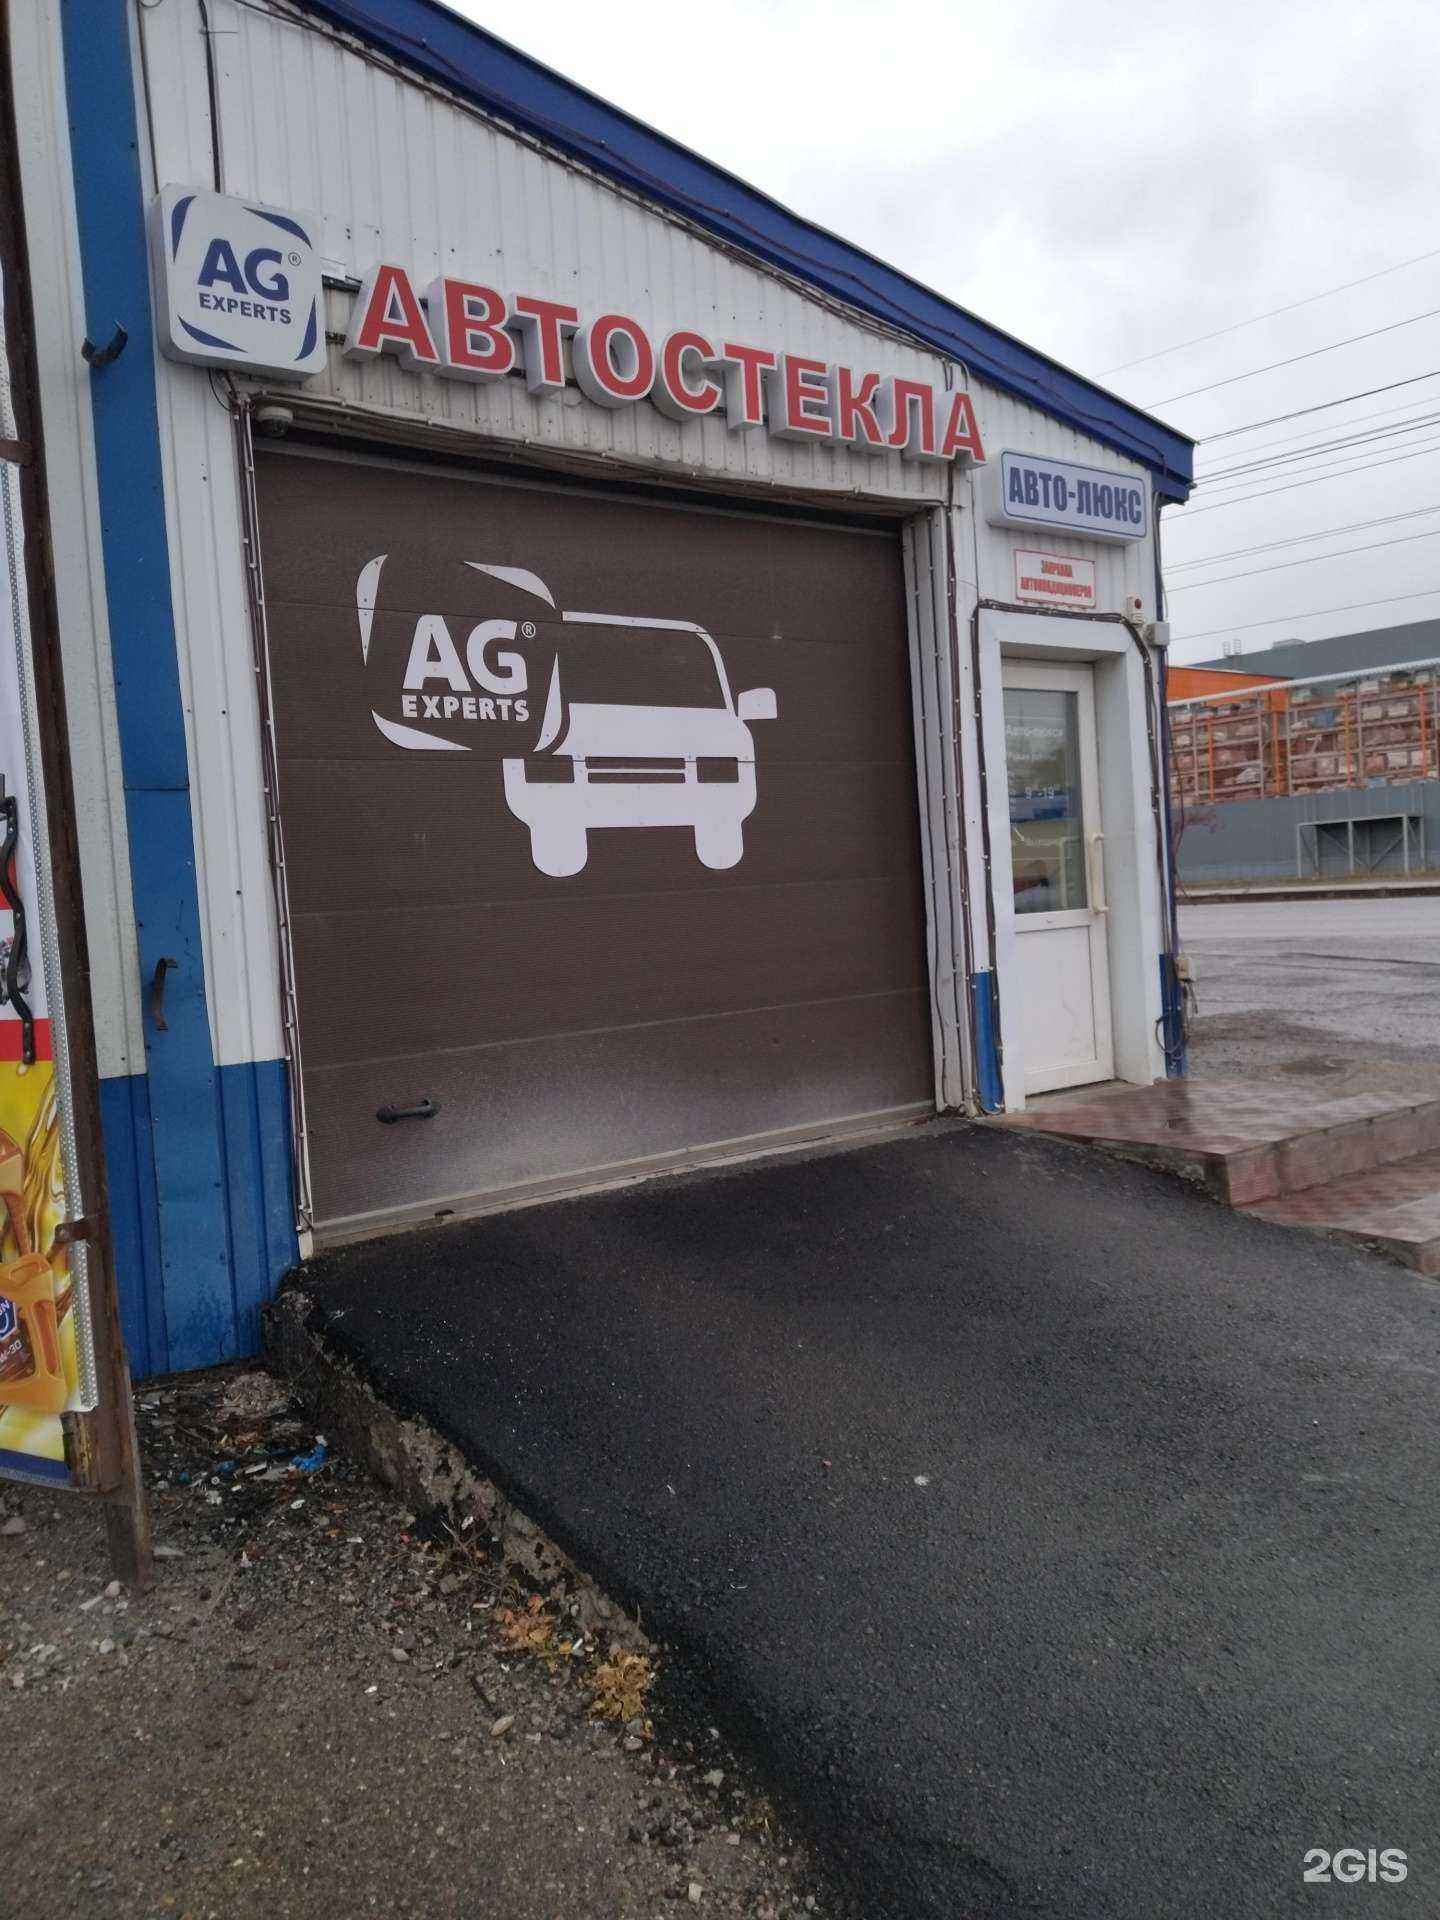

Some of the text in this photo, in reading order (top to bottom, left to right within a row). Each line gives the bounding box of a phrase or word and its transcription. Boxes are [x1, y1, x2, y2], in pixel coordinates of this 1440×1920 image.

[199, 293, 292, 325] EXPERTS
[356, 264, 985, 467] АВТОСТЕКЛА
[1009, 467, 1142, 524] АВТО-ЛЮКС
[402, 695, 529, 721] EXPERTS
